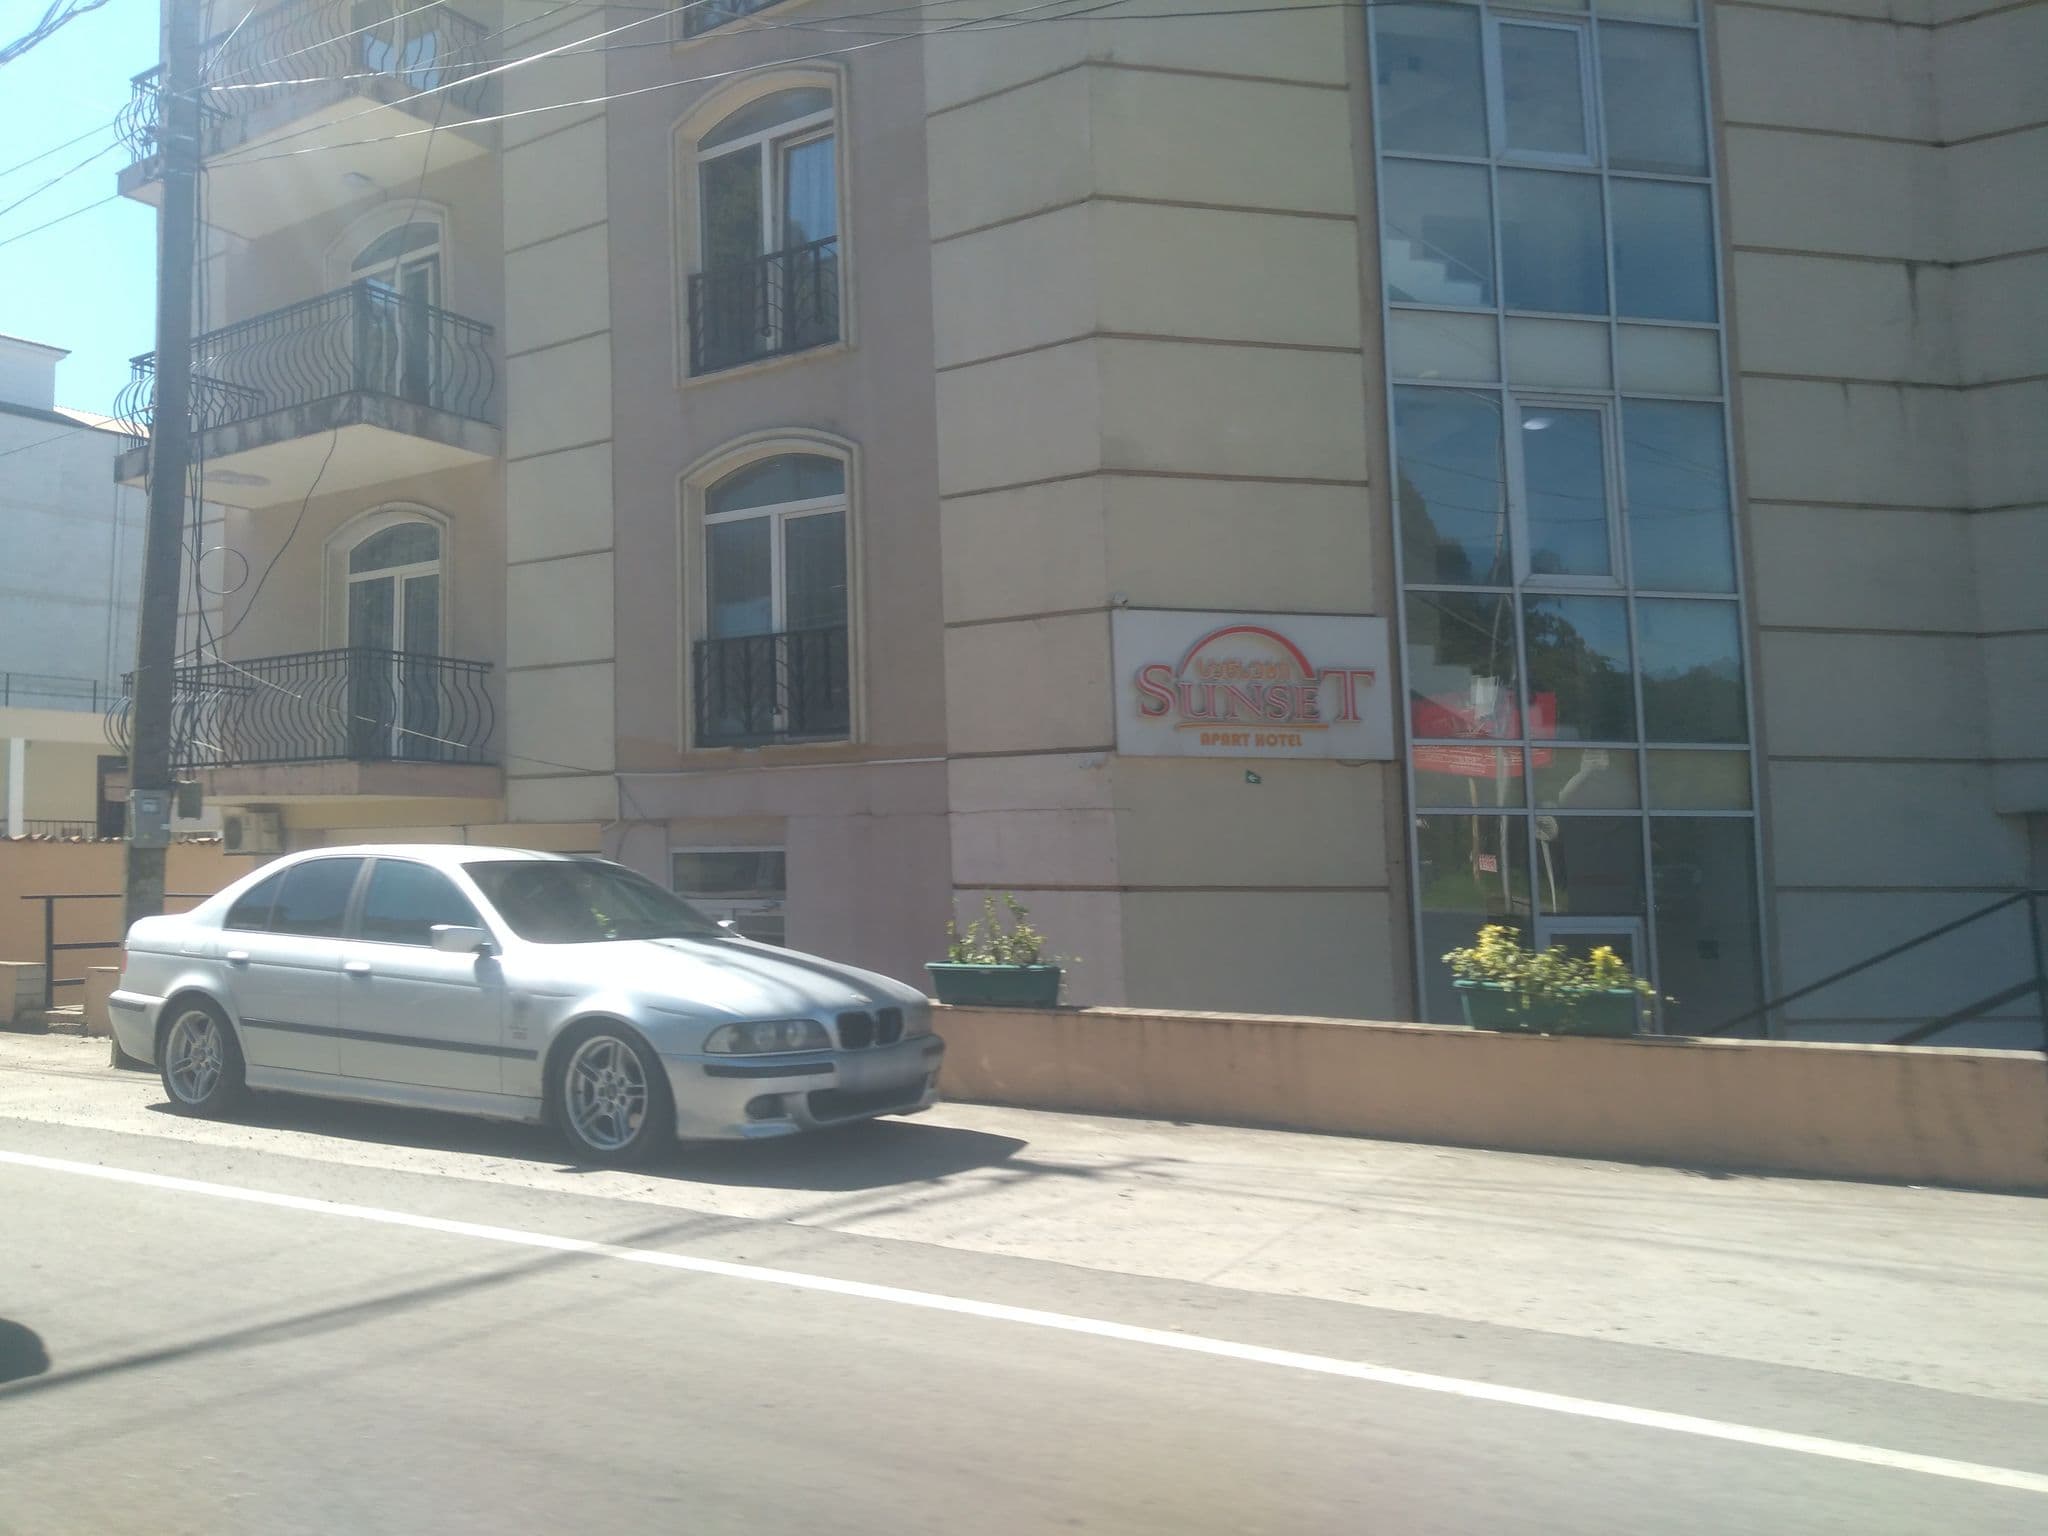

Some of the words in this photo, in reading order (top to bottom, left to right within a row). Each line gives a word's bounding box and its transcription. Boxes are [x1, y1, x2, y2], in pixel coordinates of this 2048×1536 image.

[1135, 663, 1376, 723] SUNSET
[1200, 733, 1250, 746] APART
[1254, 734, 1303, 747] HOTEL
